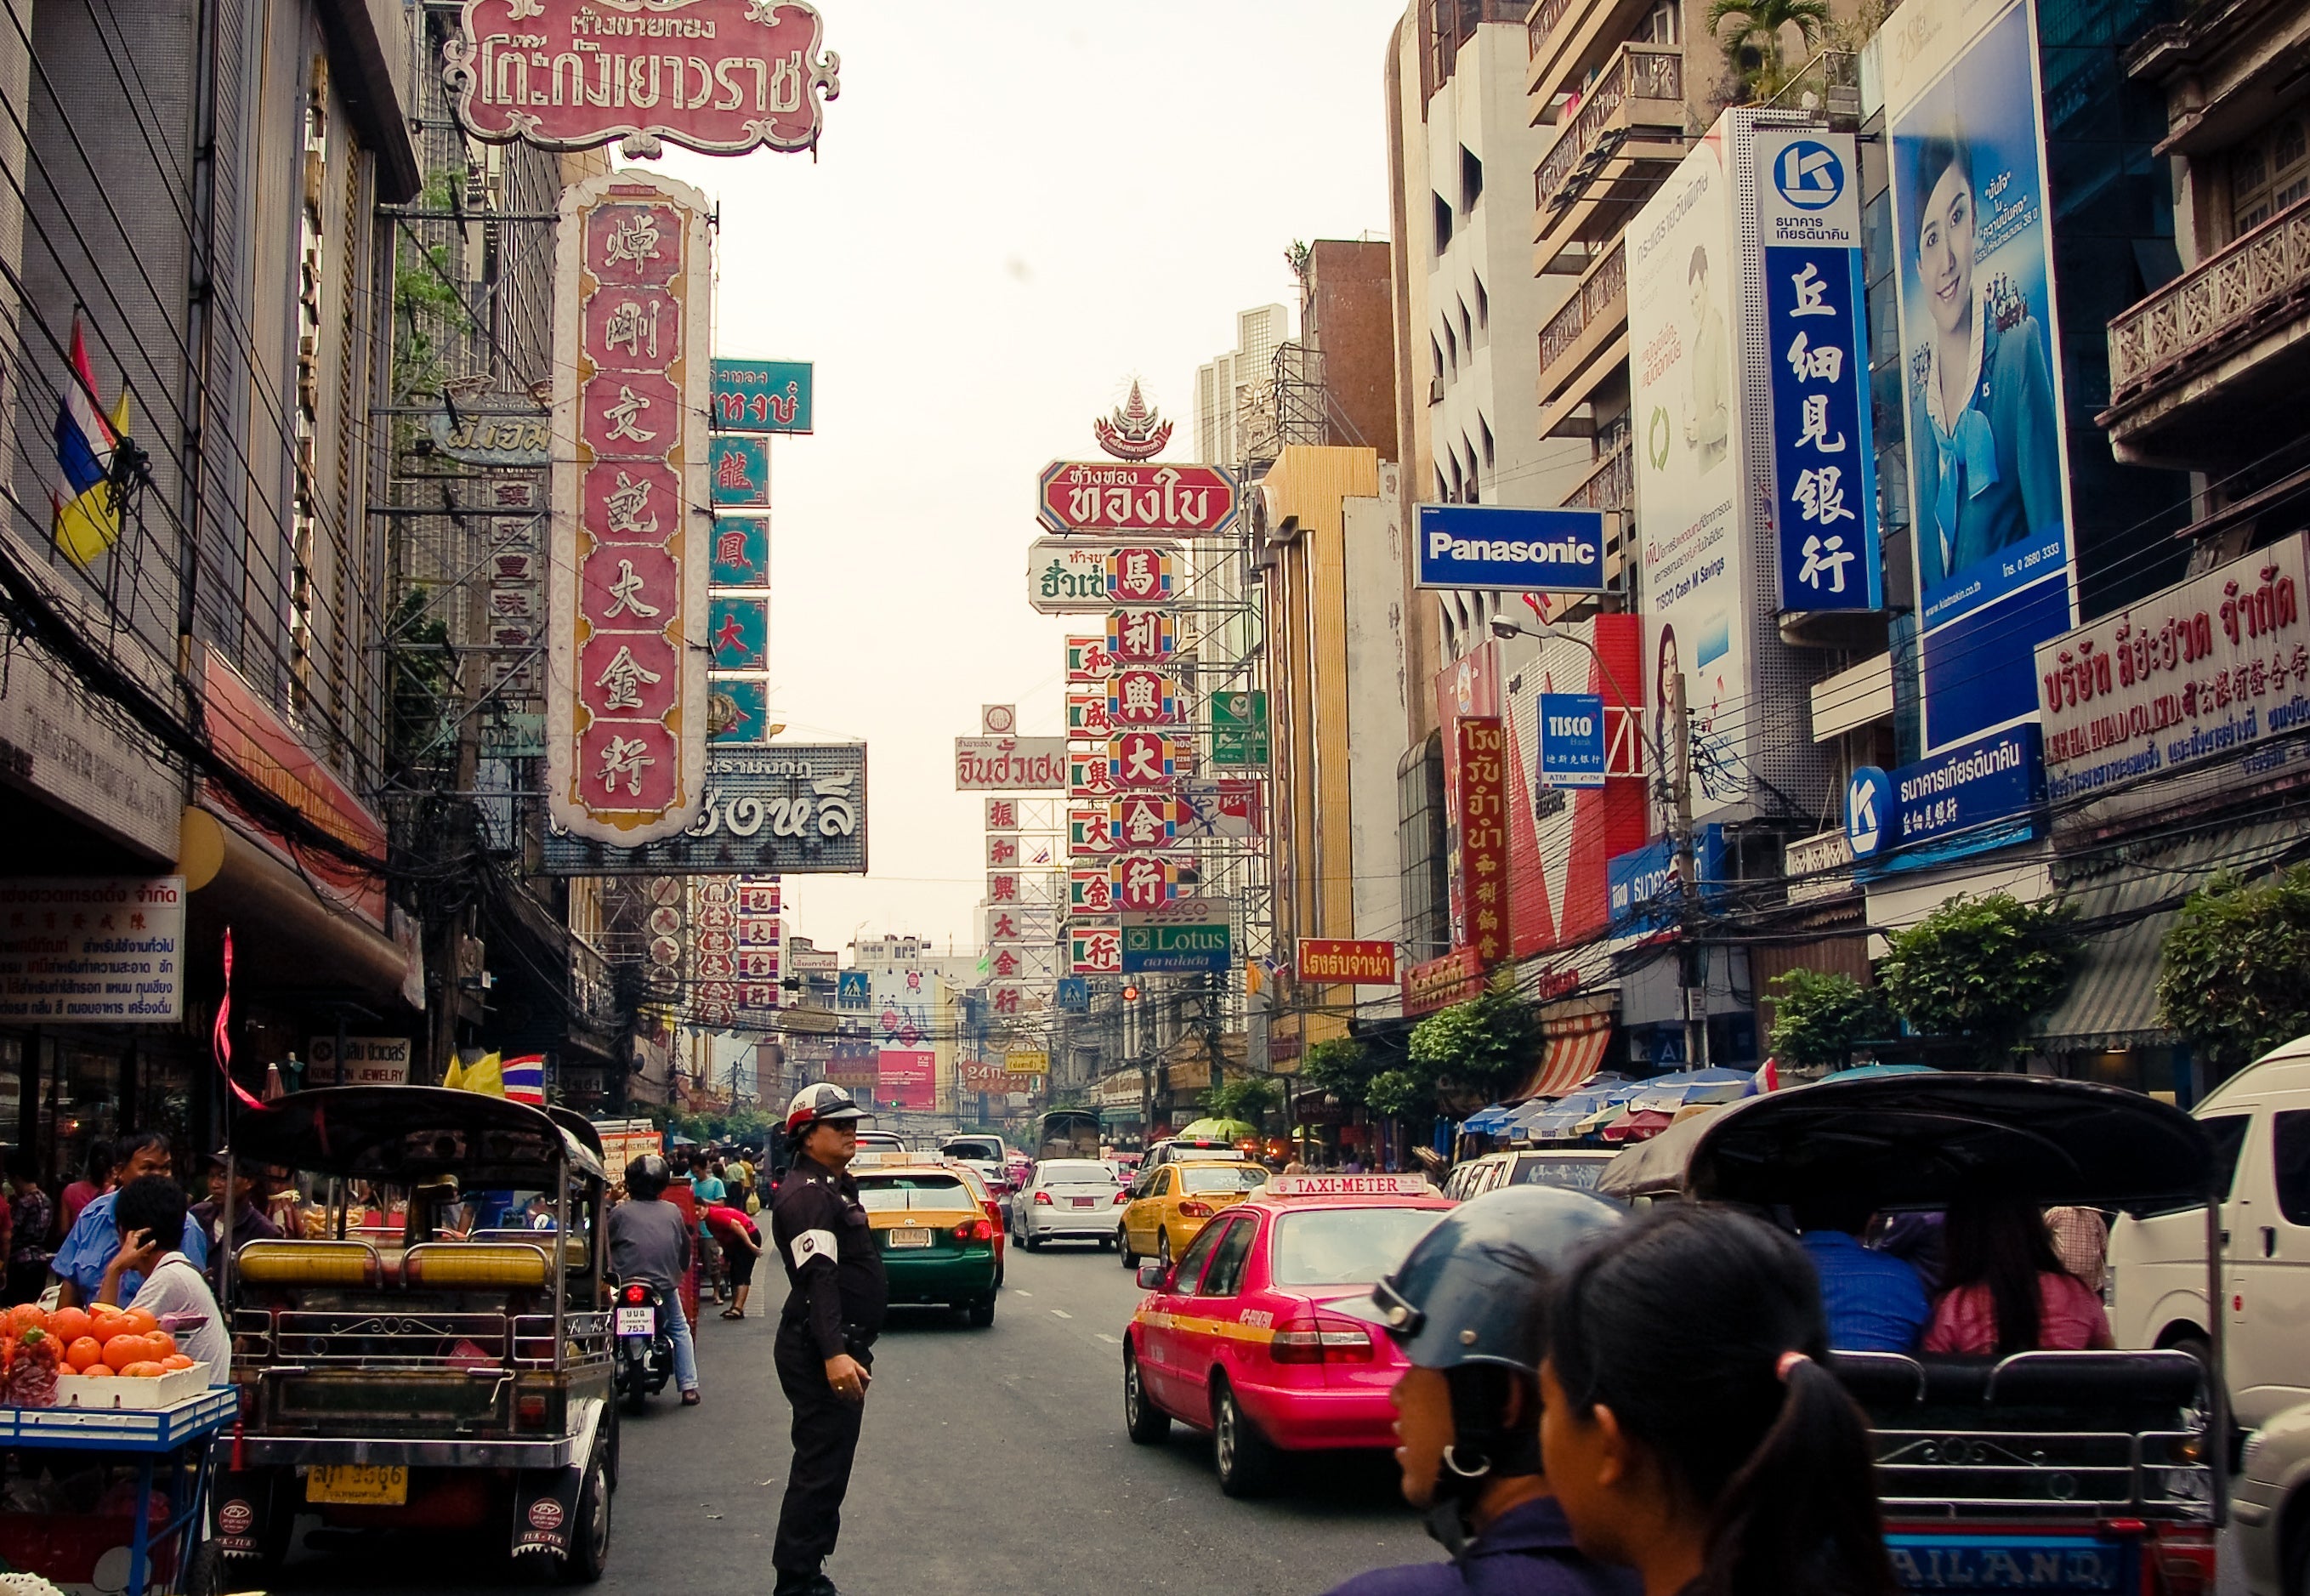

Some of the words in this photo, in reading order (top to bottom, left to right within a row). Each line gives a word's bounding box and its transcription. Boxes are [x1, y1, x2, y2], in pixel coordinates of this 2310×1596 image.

[570, 6, 717, 39] ห้างขายทอง
[481, 32, 803, 113] โต๊ะกังเยาวราช
[710, 380, 800, 424] หงษ์
[1069, 465, 1138, 486] ห้างทอง
[1067, 468, 1209, 525] ทองใบ
[1429, 531, 1595, 565] Panasonic
[2018, 559, 2023, 571] 0
[2024, 549, 2040, 569] 2680
[2041, 542, 2060, 559] 3333
[1655, 586, 1674, 613] TISCO
[1675, 577, 1691, 599] Cash
[1692, 570, 1699, 588] M
[1700, 556, 1725, 583] Savings
[2043, 638, 2113, 714] บริษัท
[2218, 563, 2297, 646] จำกัด
[1548, 716, 1592, 737] TISCO
[2044, 732, 2069, 766] LEE
[2069, 725, 2090, 758] HA
[2090, 711, 2129, 752] HUAD
[135, 883, 177, 903] จำกัด
[1157, 928, 1225, 950] Lotus
[1301, 941, 1391, 977] โรงรับจำนำ
[359, 1071, 404, 1082] JEWELRY
[1295, 1178, 1399, 1193] TAXI-METER
